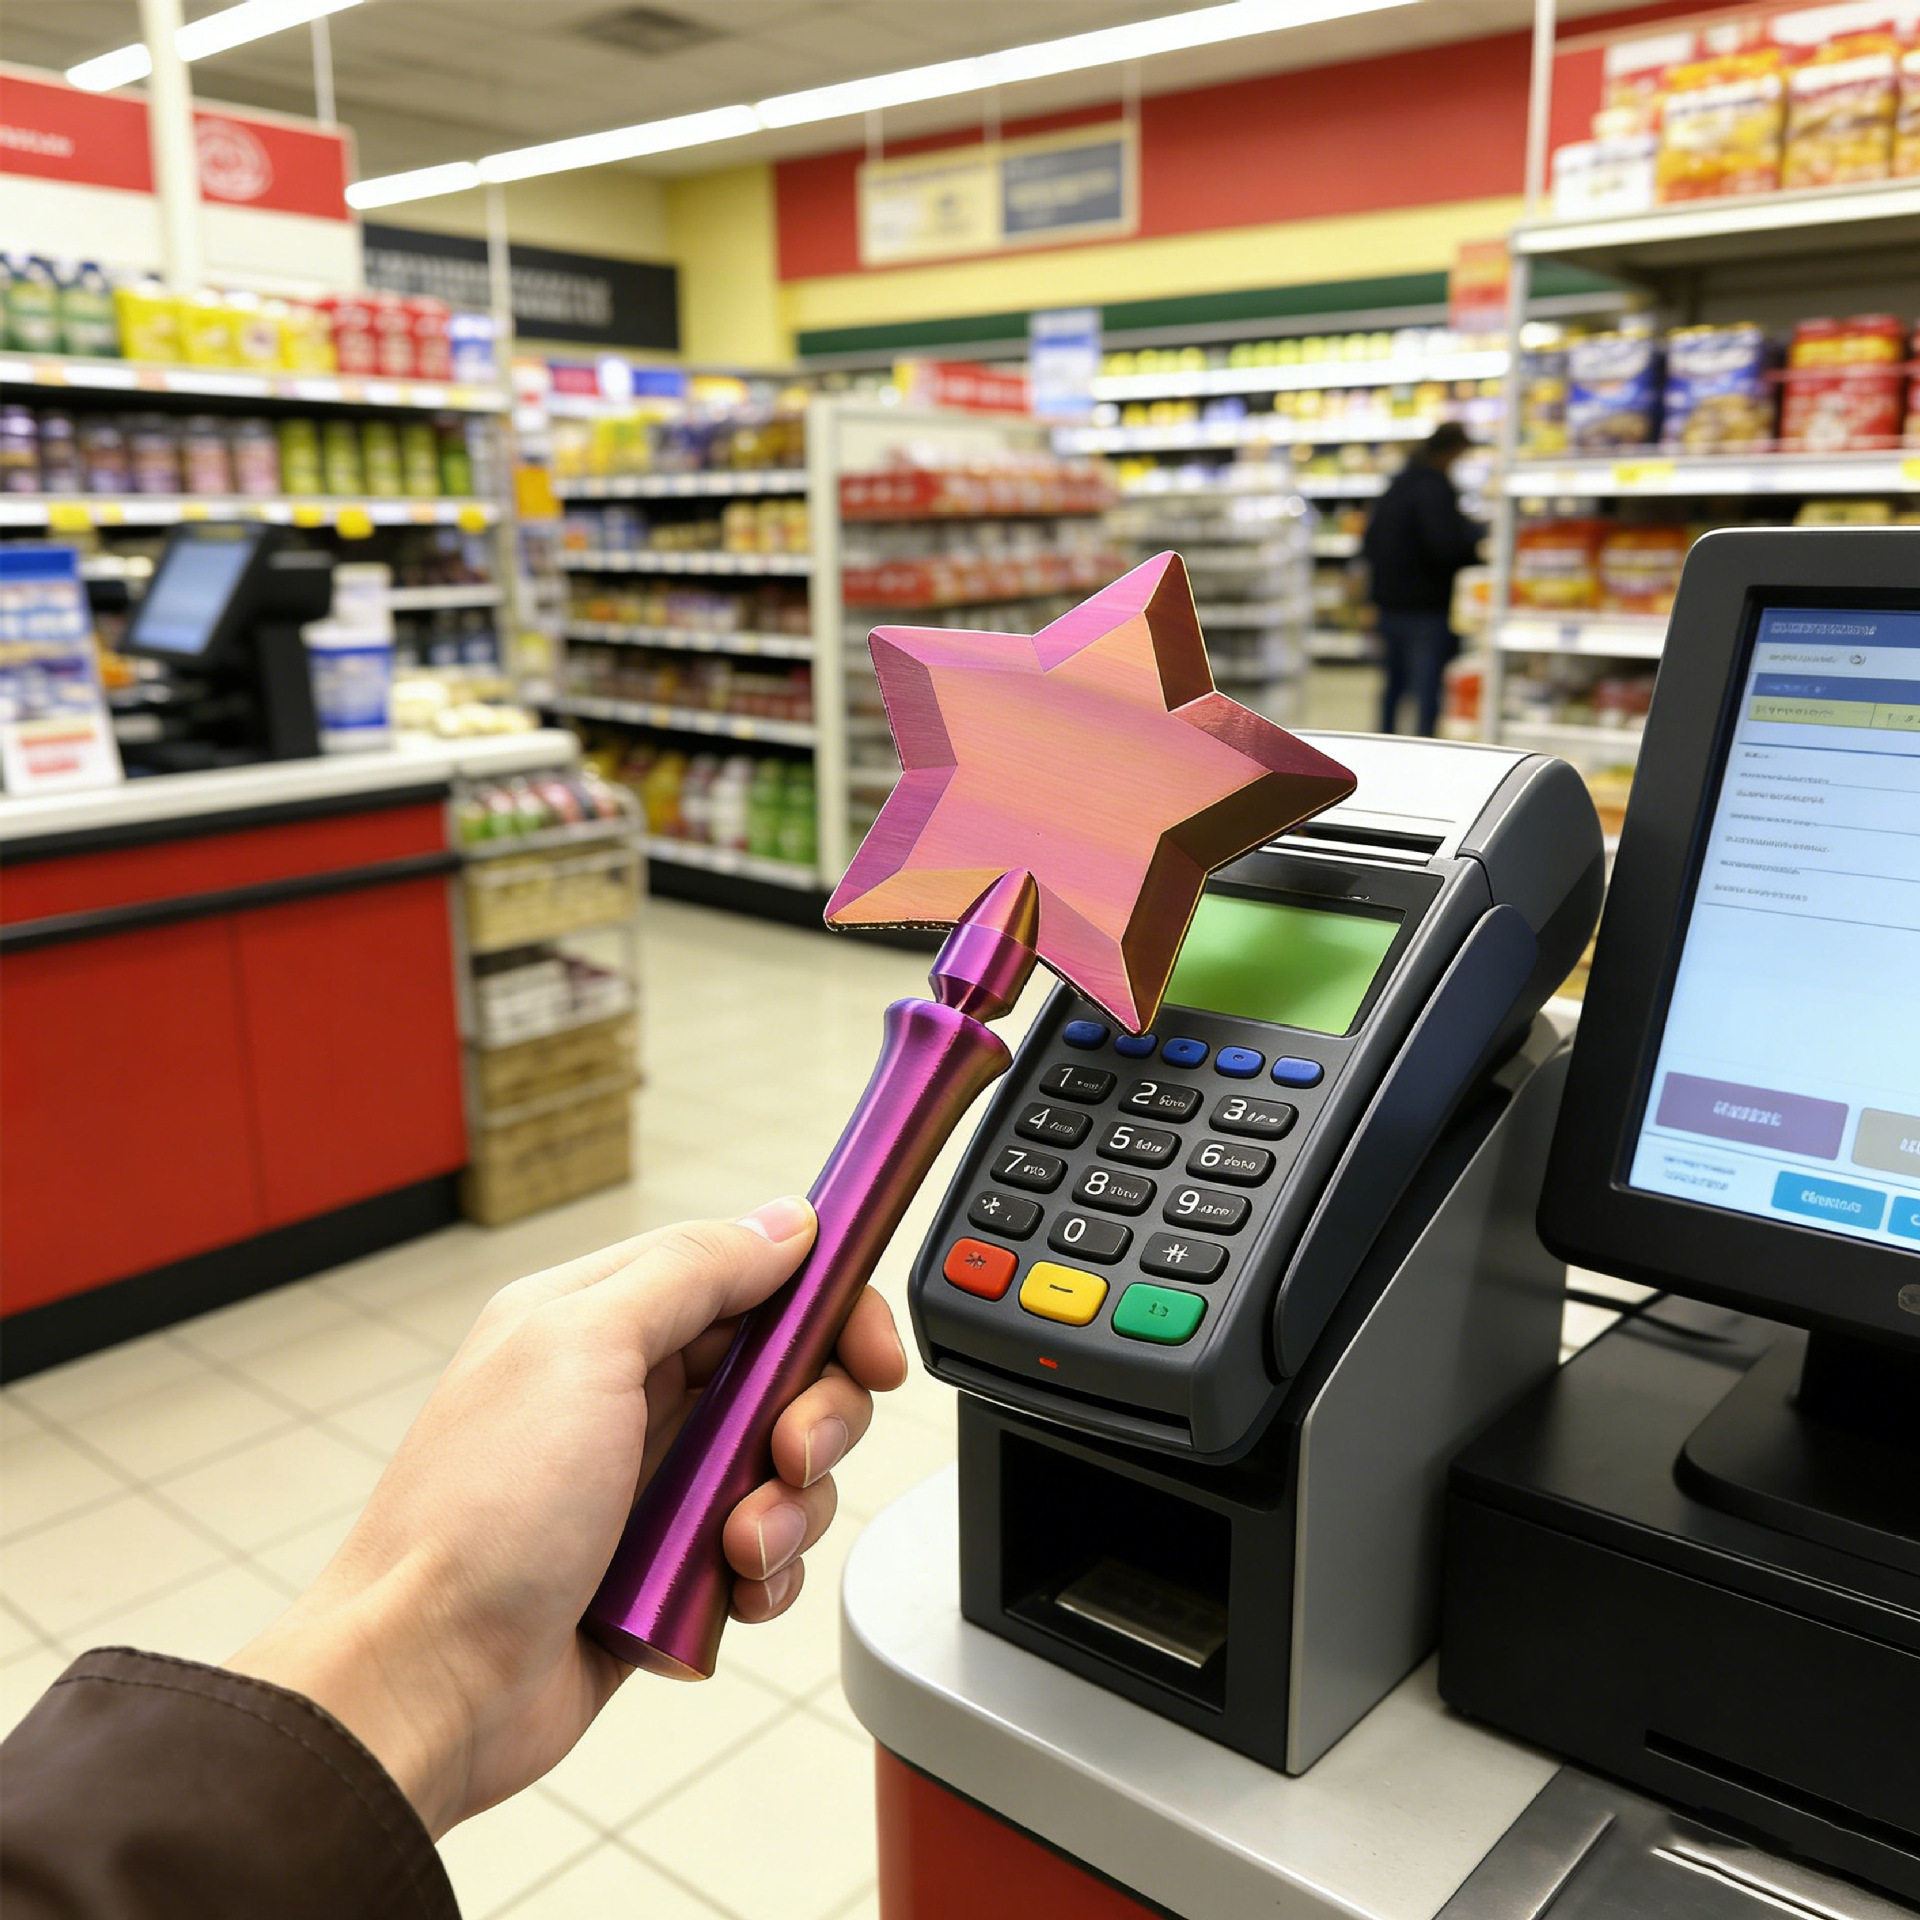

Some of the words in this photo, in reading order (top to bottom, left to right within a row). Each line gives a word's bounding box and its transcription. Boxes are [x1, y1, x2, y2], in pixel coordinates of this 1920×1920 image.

[1060, 1068, 1073, 1088] 1
[1131, 1082, 1157, 1105] 2
[1028, 1108, 1050, 1130] 4
[1223, 1099, 1246, 1120] 3
[1109, 1126, 1134, 1149] 5
[1005, 1150, 1027, 1173] 7
[1200, 1144, 1225, 1168] 6
[1084, 1172, 1110, 1195] 8
[1176, 1190, 1199, 1214] 9
[1064, 1218, 1086, 1243] 0
